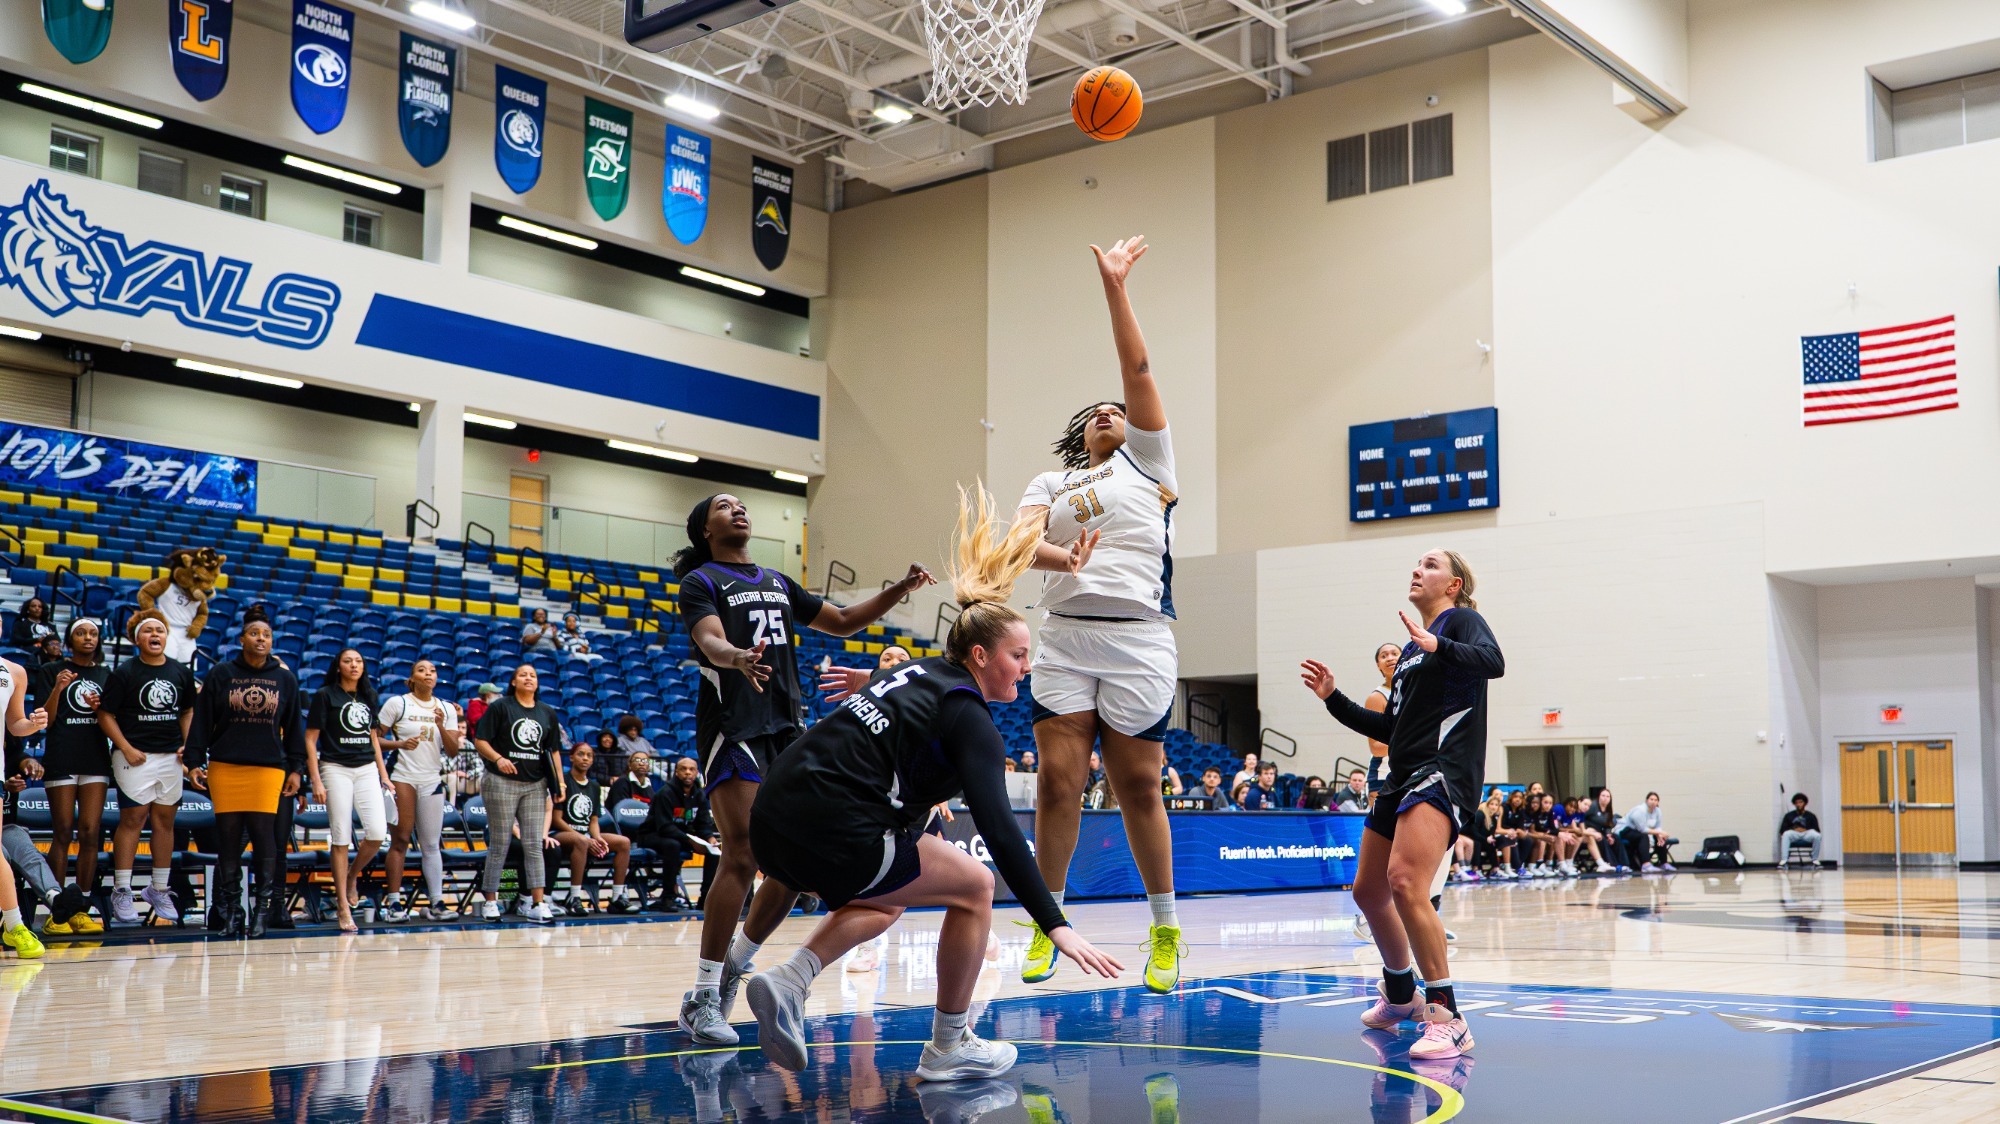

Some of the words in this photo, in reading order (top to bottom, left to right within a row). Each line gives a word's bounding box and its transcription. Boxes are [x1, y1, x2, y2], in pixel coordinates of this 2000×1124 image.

[305, 3, 343, 27] NORTH
[296, 14, 350, 42] ALABAMA
[411, 41, 446, 62] NORTH
[406, 52, 449, 76] FLORIDA
[412, 74, 442, 93] NORTH
[405, 80, 449, 112] FLORIDA
[502, 85, 539, 107] QUEENS
[589, 115, 628, 137] STETSON
[677, 135, 700, 152] WEST
[670, 143, 706, 165] GEORGIA
[672, 166, 702, 195] UWG
[1454, 434, 1484, 449] GUEST
[1359, 448, 1384, 461] HOME
[1409, 447, 1432, 458] PERIOD
[105, 455, 215, 500] DEN
[1401, 478, 1425, 488] PLAYER
[1424, 475, 1441, 485] FOUL
[1467, 470, 1489, 480] FOULS
[1355, 482, 1375, 493] FOULS
[1068, 487, 1105, 523] 31
[1410, 503, 1432, 513] MATCH
[1467, 497, 1489, 507] SCORE
[1356, 509, 1376, 519] SCORE
[727, 591, 762, 607] SUGAR
[761, 591, 790, 606] BEARS
[748, 609, 788, 647] 25
[869, 664, 928, 698] 5
[420, 725, 435, 742] 21
[1219, 846, 1247, 860] Fluent
[1247, 846, 1256, 859] in
[1256, 845, 1277, 859] tech.
[1277, 844, 1315, 859] Proficient
[1314, 844, 1322, 858] in
[1322, 844, 1356, 861] people.
